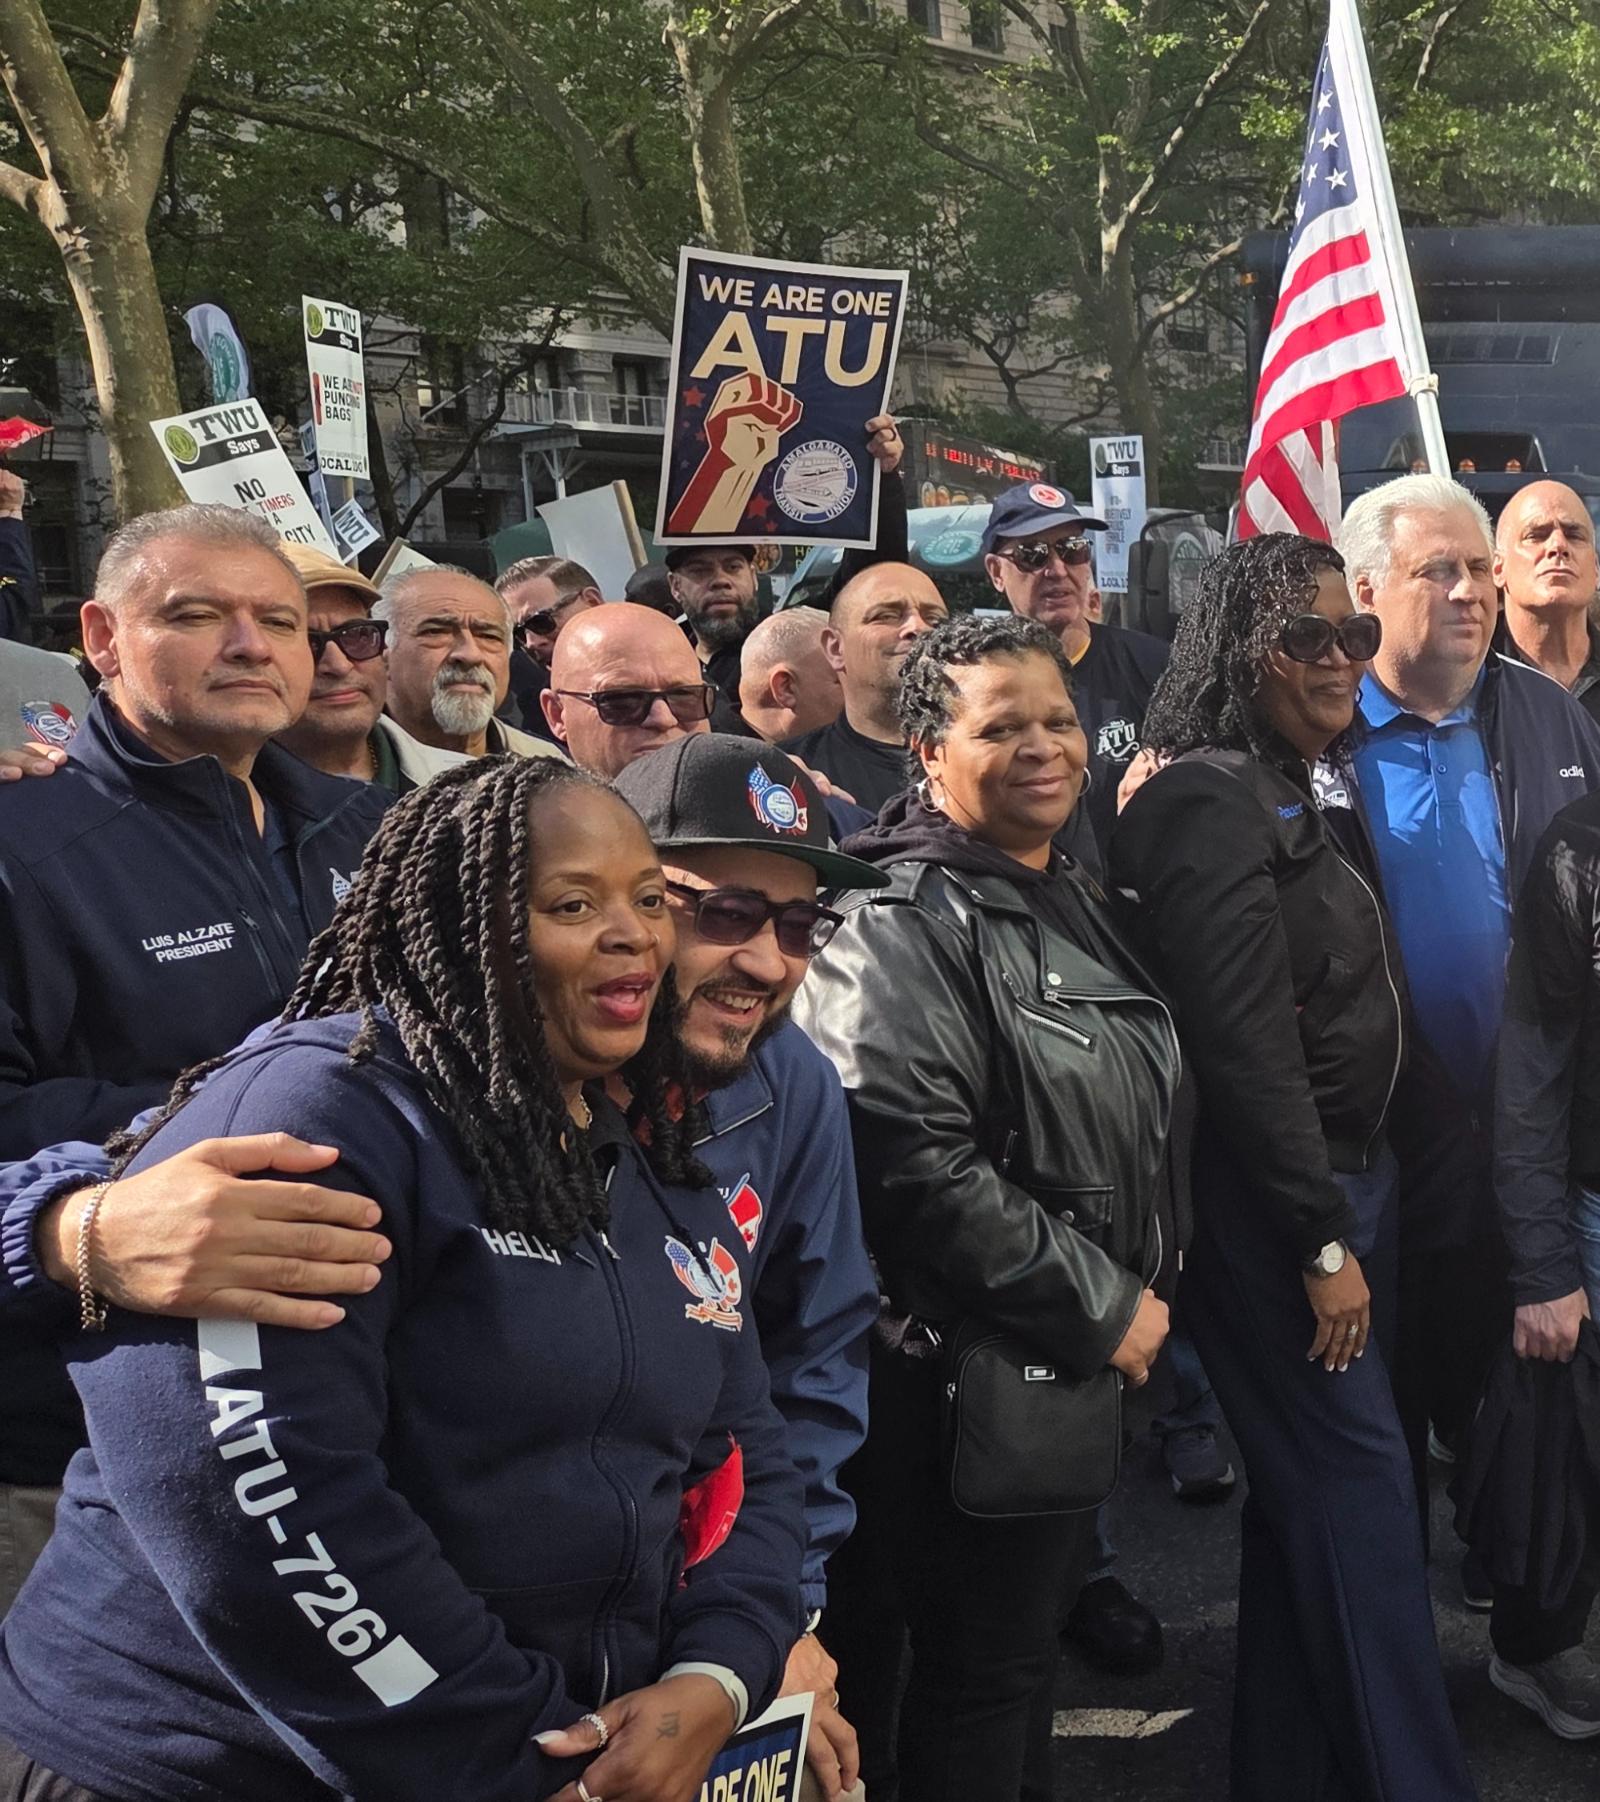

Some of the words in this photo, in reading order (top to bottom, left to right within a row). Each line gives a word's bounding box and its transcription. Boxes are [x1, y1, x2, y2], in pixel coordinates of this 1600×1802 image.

[699, 274, 755, 307] WE
[761, 283, 825, 313] ARE
[831, 289, 892, 316] ONE
[324, 306, 357, 334] TWU
[690, 311, 888, 386] ATU
[323, 374, 340, 389] WE
[189, 405, 260, 442] TWU
[325, 407, 352, 421] BAGS
[227, 438, 260, 455] Says
[781, 442, 853, 471] AMALGAMATED
[1107, 441, 1138, 460] TWU
[320, 458, 352, 472] OCAL
[1112, 464, 1130, 477] Says
[233, 478, 267, 504] NO
[256, 493, 295, 513] TIMERS
[776, 488, 804, 520] TRANSIT
[826, 487, 856, 517] UNION
[272, 512, 282, 525] A
[284, 523, 316, 543] CITY
[1096, 723, 1136, 756] ATU
[141, 934, 175, 951] LUIS
[177, 922, 236, 945] ALZATE
[155, 936, 233, 963] PRESIDENT
[468, 1222, 562, 1266] HELL
[205, 1385, 388, 1657] ATU-726
[743, 1748, 793, 1802] ONE
